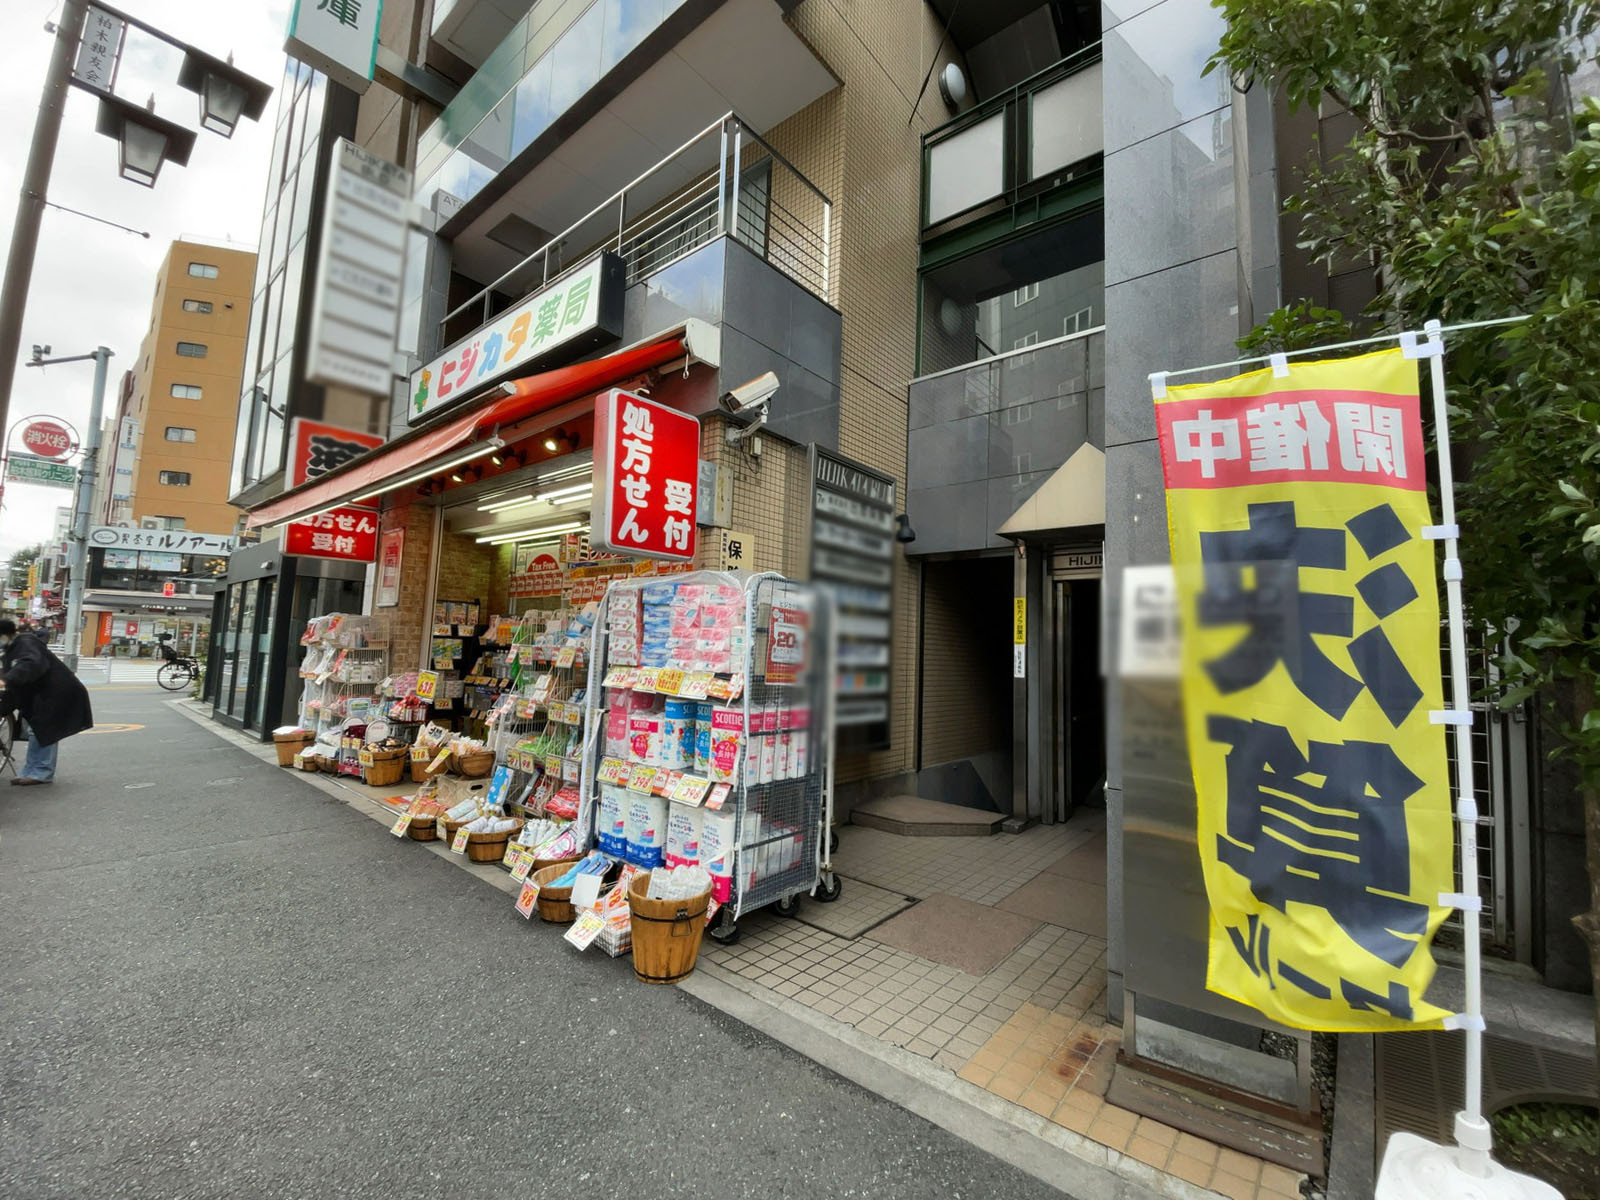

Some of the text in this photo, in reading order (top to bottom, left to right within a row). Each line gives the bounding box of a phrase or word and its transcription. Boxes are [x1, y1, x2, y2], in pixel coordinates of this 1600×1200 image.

[437, 276, 592, 399] ヒジカタ薬局
[27, 430, 68, 448] 消火栓
[620, 401, 654, 543] 処方せん
[662, 480, 693, 551] 受付
[311, 532, 355, 553] 受付
[532, 561, 556, 571] Tax Free
[521, 891, 534, 908] 98
